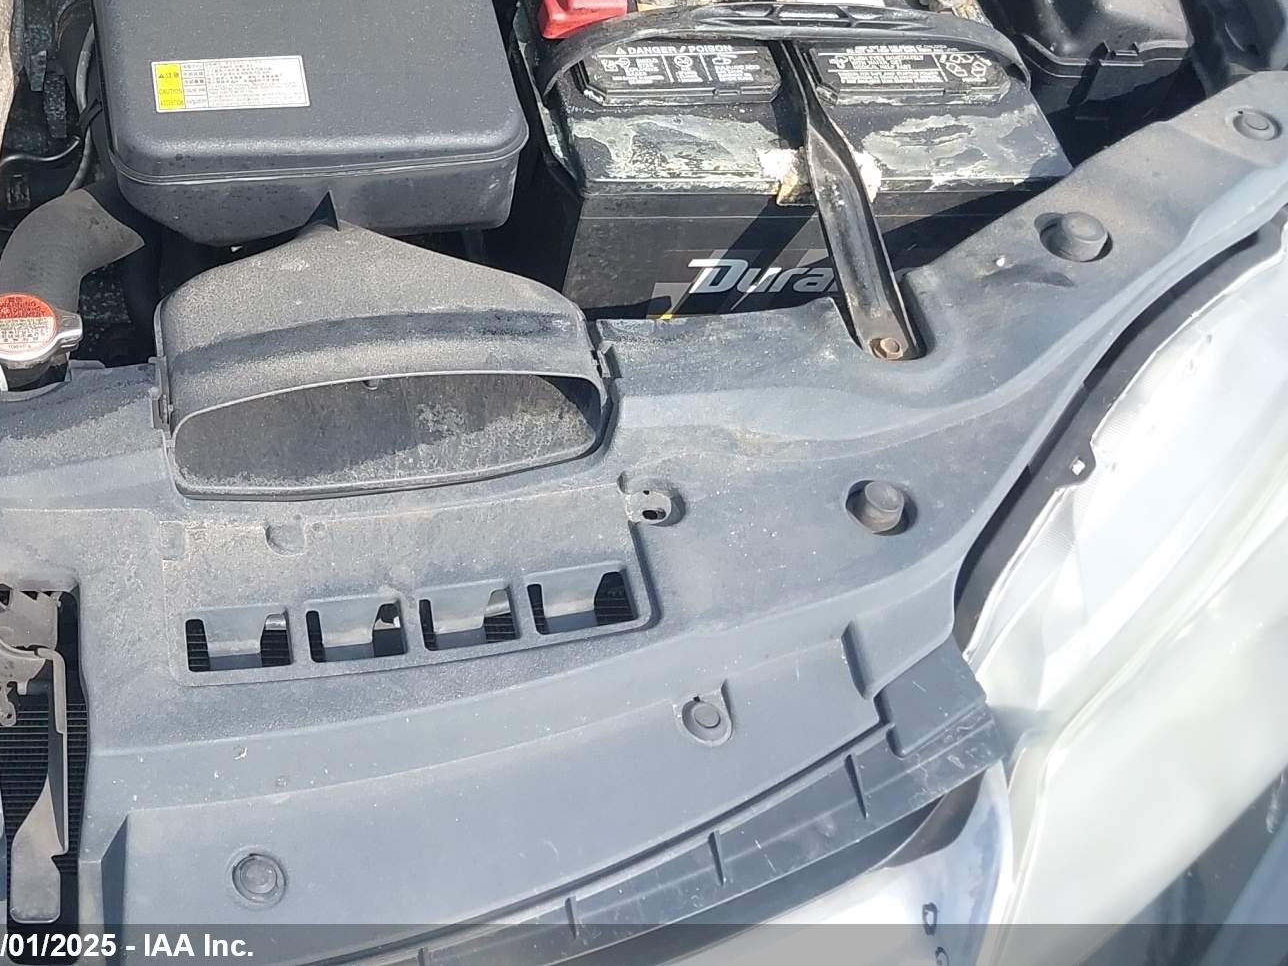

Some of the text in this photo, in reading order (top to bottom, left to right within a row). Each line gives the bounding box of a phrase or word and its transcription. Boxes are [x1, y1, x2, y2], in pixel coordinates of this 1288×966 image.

[628, 46, 677, 54] DANGER
[688, 44, 733, 53] POISON
[688, 259, 839, 294] Dura
